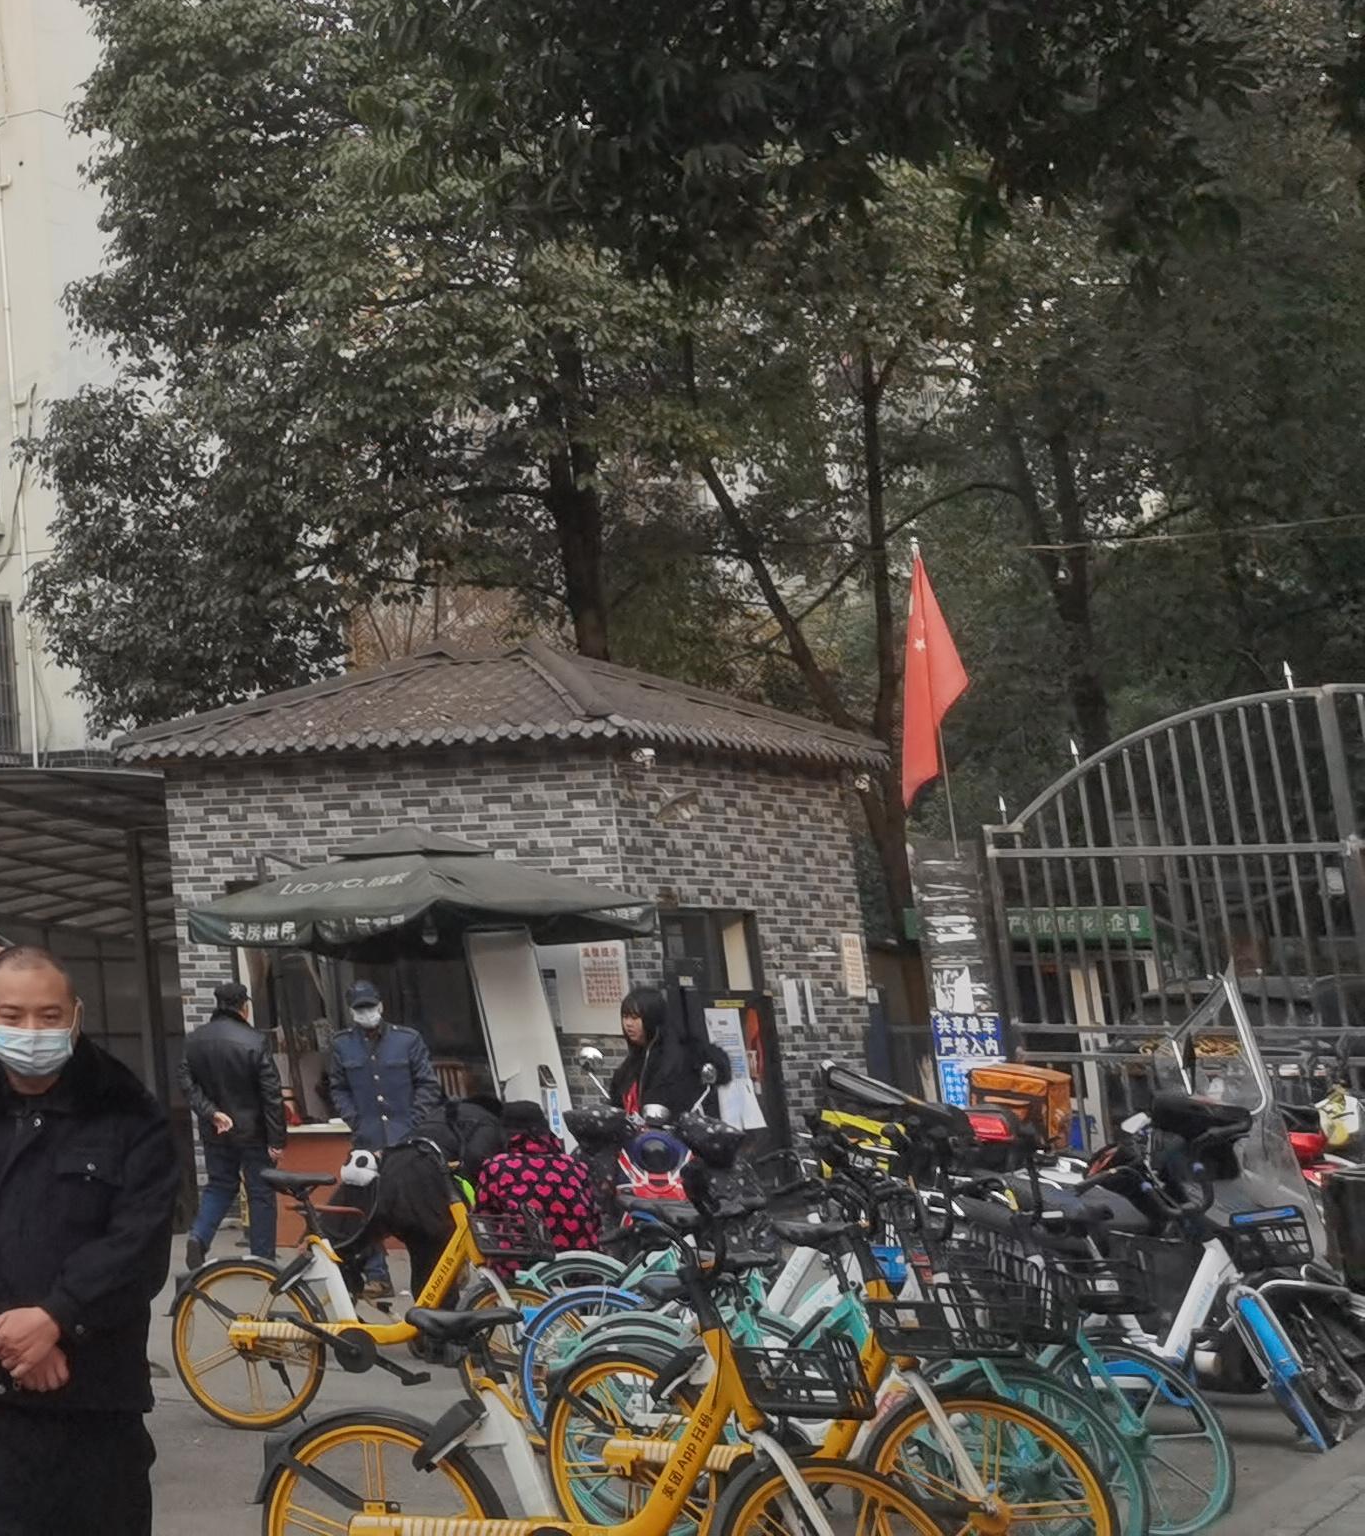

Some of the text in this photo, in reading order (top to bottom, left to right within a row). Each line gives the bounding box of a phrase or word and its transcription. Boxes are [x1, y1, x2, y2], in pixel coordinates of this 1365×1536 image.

[229, 921, 296, 941] 买房租房
[936, 1016, 998, 1036] 共享单车
[940, 1037, 999, 1056] 严禁入内
